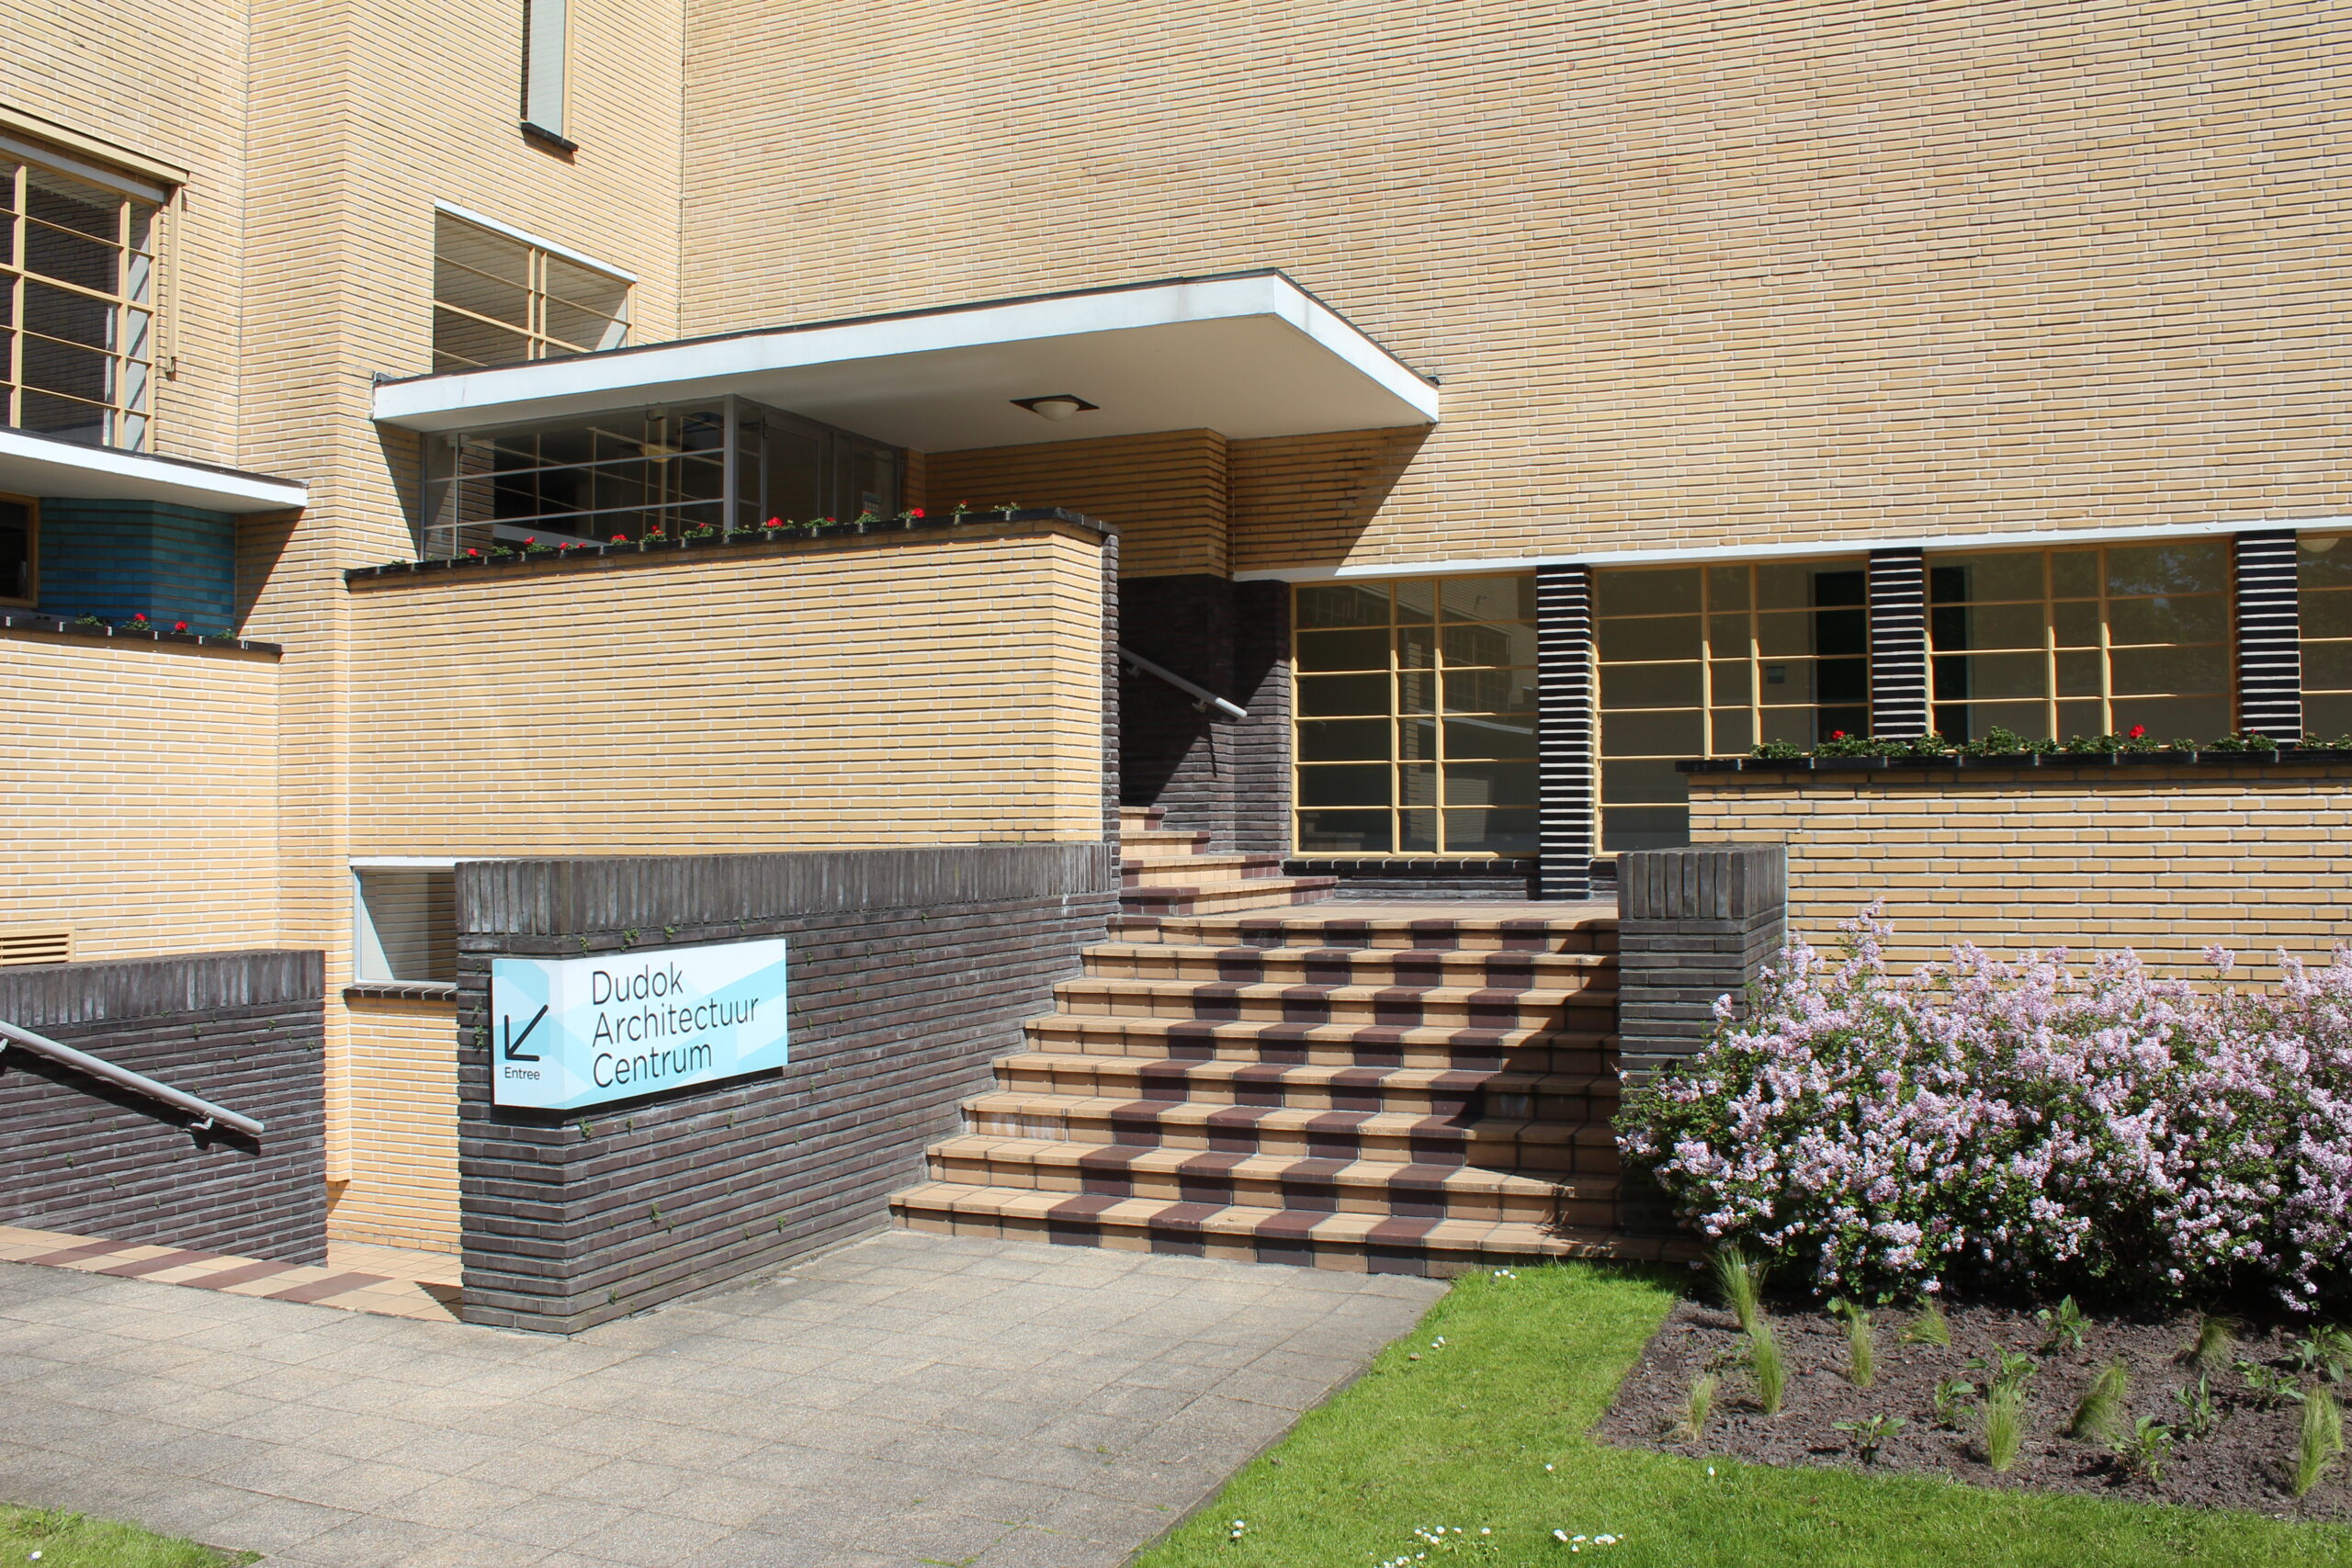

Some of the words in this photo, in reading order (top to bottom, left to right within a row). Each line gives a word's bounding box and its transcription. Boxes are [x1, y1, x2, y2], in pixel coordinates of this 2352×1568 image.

[593, 962, 683, 1005] Dudok
[593, 998, 759, 1047] Architectuur
[504, 1066, 540, 1080] Entree
[594, 1043, 712, 1088] Centrum
